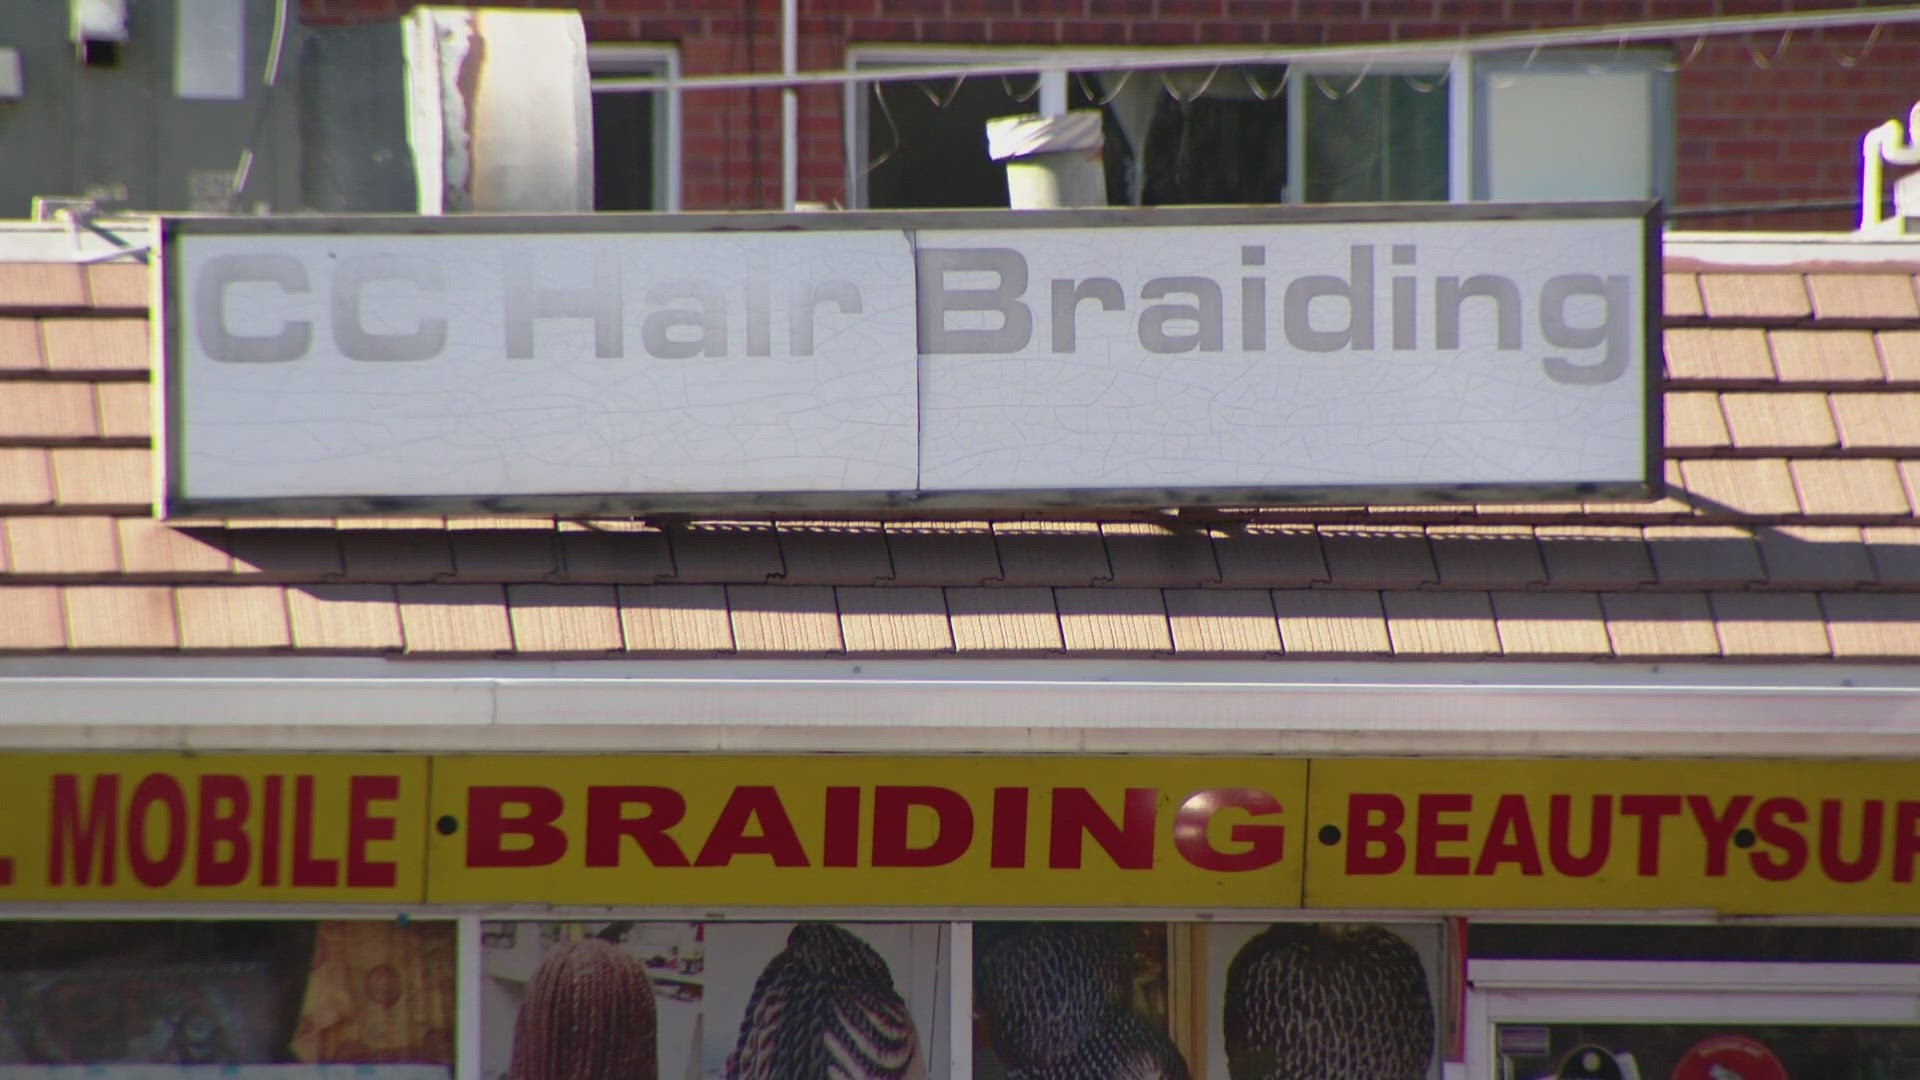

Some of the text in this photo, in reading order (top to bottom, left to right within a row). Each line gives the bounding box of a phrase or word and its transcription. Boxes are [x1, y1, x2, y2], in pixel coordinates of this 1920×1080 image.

[197, 244, 1632, 386] CC Hair Braiding
[48, 772, 402, 889] MOBILE
[464, 784, 1286, 873] BRAIDING
